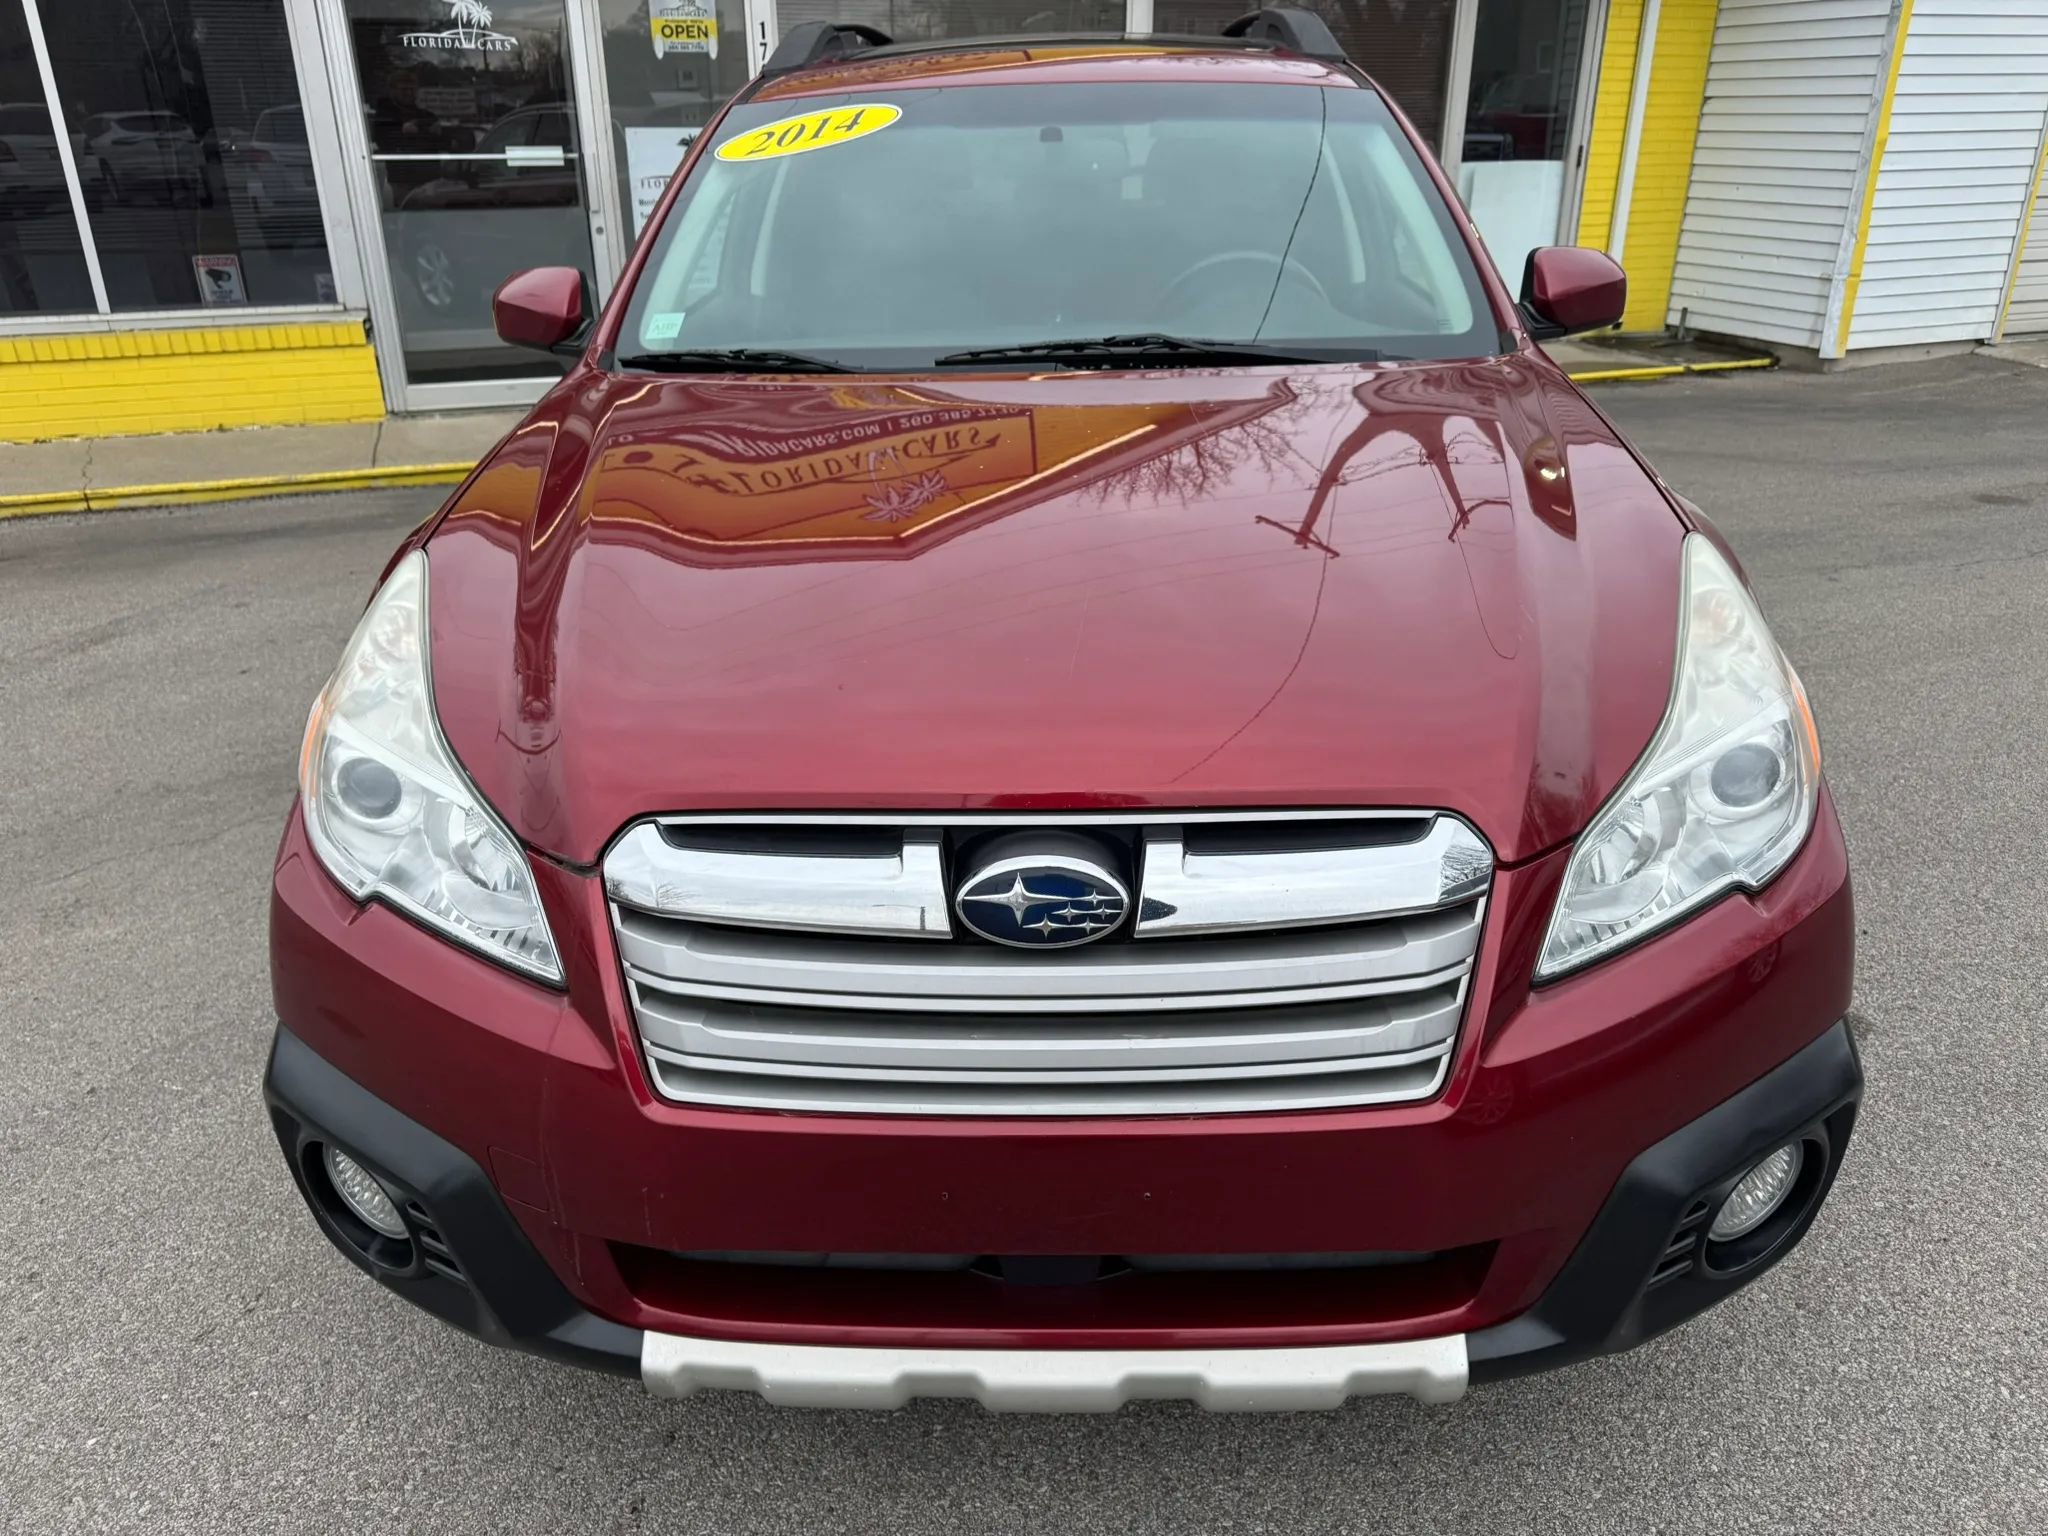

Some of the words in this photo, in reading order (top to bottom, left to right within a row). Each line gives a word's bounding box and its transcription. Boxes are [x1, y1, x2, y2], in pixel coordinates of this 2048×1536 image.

[661, 24, 708, 39] OPEN
[403, 36, 460, 48] FLORIDA
[478, 39, 512, 51] CARS
[744, 108, 866, 157] 2014
